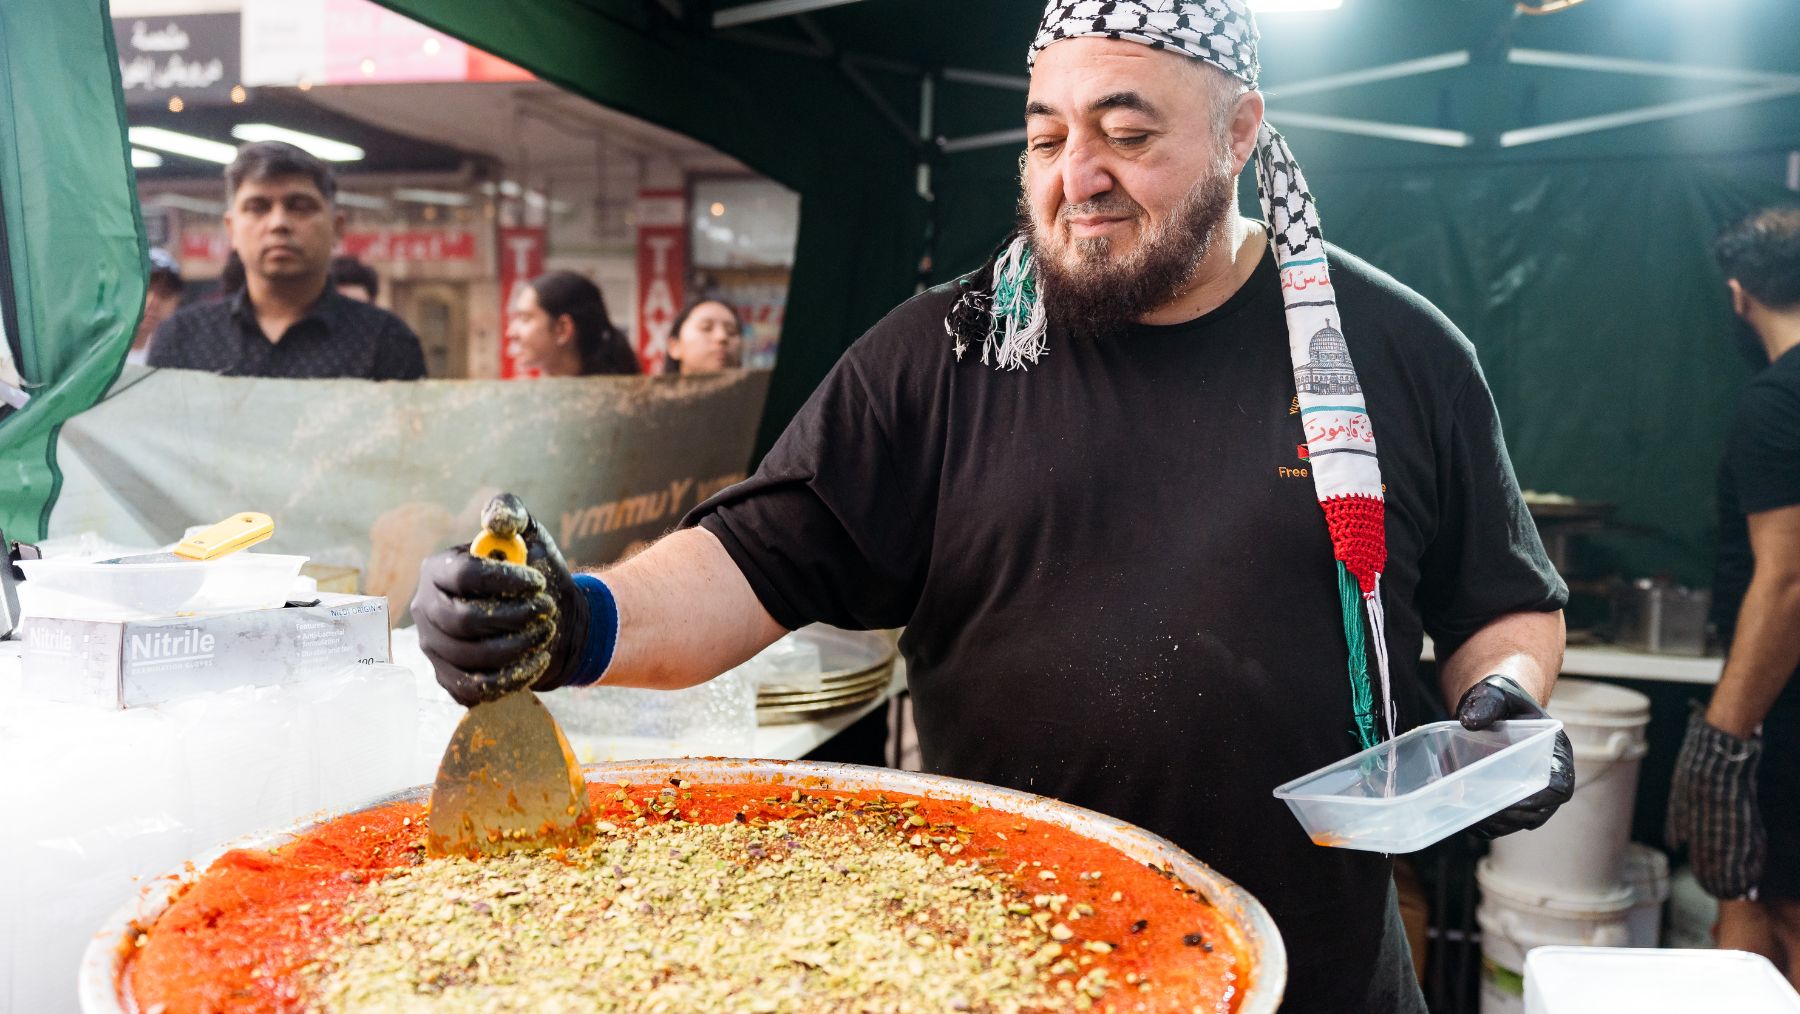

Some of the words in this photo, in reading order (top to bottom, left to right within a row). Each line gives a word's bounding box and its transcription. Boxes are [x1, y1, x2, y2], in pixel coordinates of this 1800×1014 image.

[1278, 466, 1308, 478] Free
[29, 627, 72, 651] Nitrile
[131, 628, 215, 660] Nitrile
